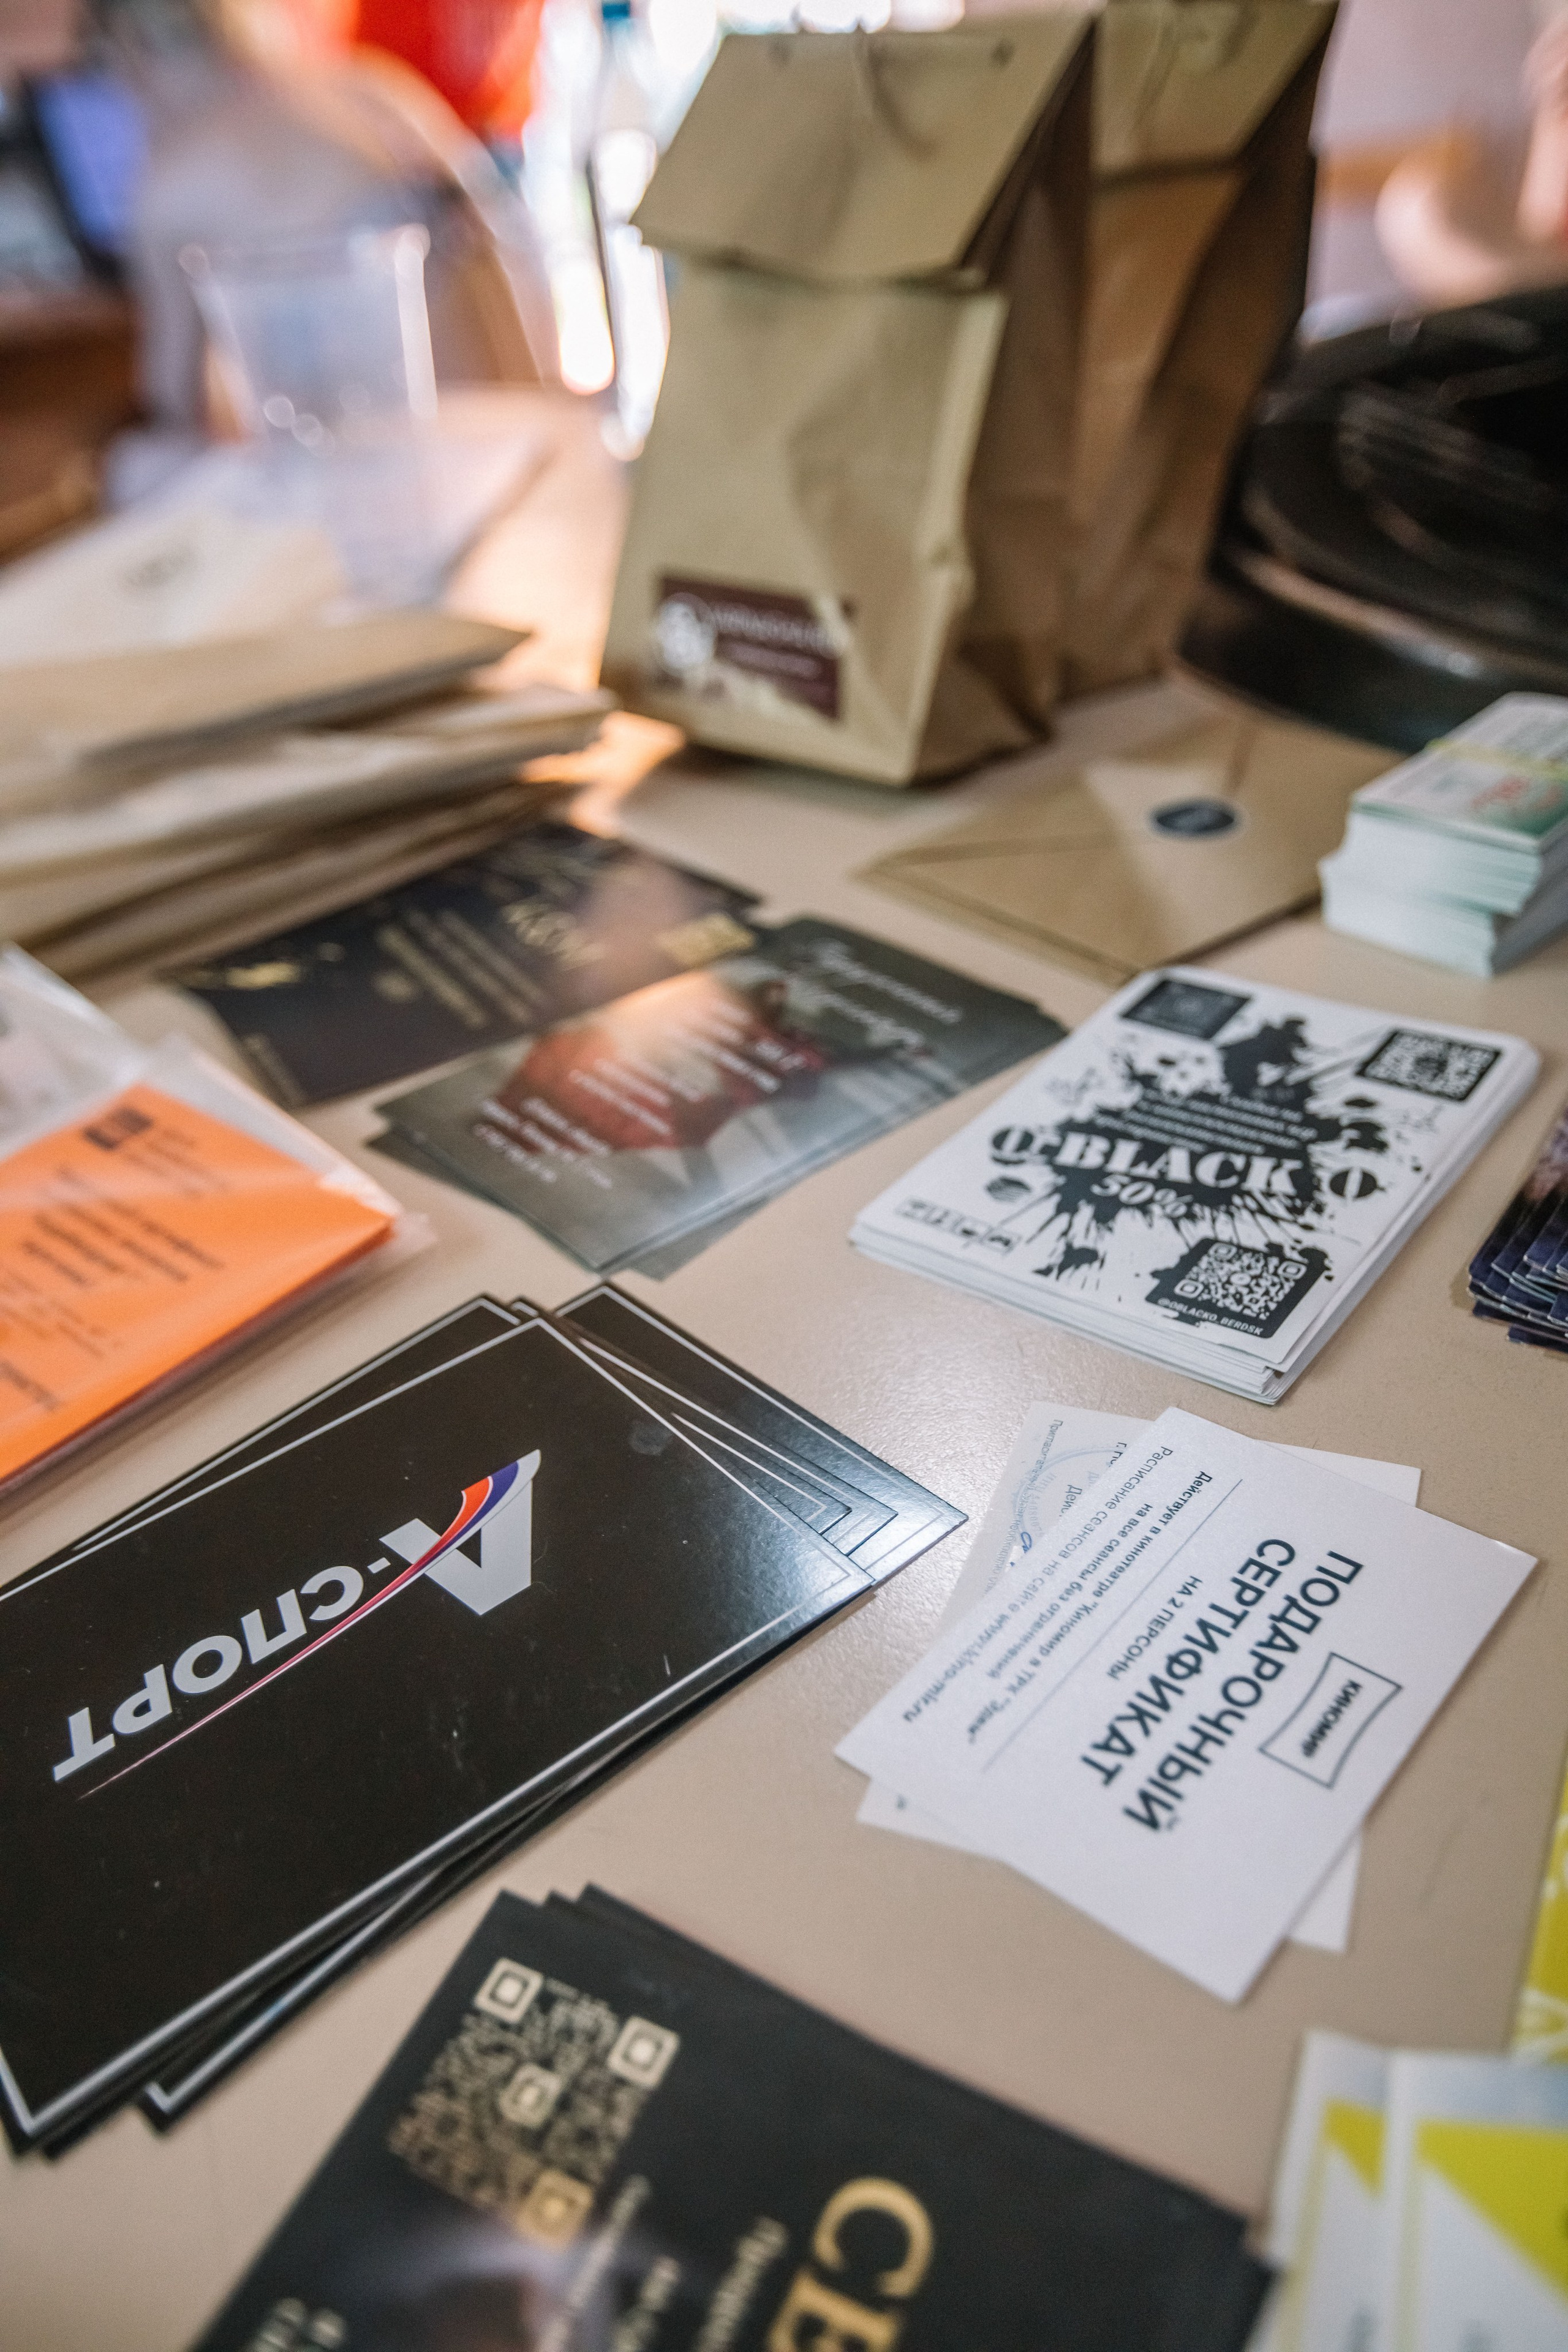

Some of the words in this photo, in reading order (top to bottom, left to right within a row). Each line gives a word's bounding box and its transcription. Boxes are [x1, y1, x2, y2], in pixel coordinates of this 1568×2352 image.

[1104, 1446, 1174, 1510] Расписание
[1135, 1503, 1153, 1518] на
[1158, 1471, 1213, 1526] Действует
[1058, 1510, 1108, 1559] сеансов
[1117, 1518, 1140, 1538] все
[1149, 1526, 1162, 1535] в
[1041, 1559, 1061, 1577] на
[1078, 1539, 1120, 1581] сеансы
[1092, 1535, 1153, 1598] кинотеатре
[1007, 1577, 1046, 1613] сайте
[1058, 1581, 1084, 1602] без
[1167, 1597, 1184, 1609] 2
[1177, 1575, 1203, 1596] НА
[1081, 1539, 1297, 1787] СЕРТИФИКАТ
[1107, 1608, 1175, 1680] ПЕРСОНЫ
[1006, 1670, 1036, 1695] ТРК
[1123, 1550, 1365, 1832] ПОДАРОЧНЫЙ
[1302, 1679, 1362, 1758] КИНОМИР
